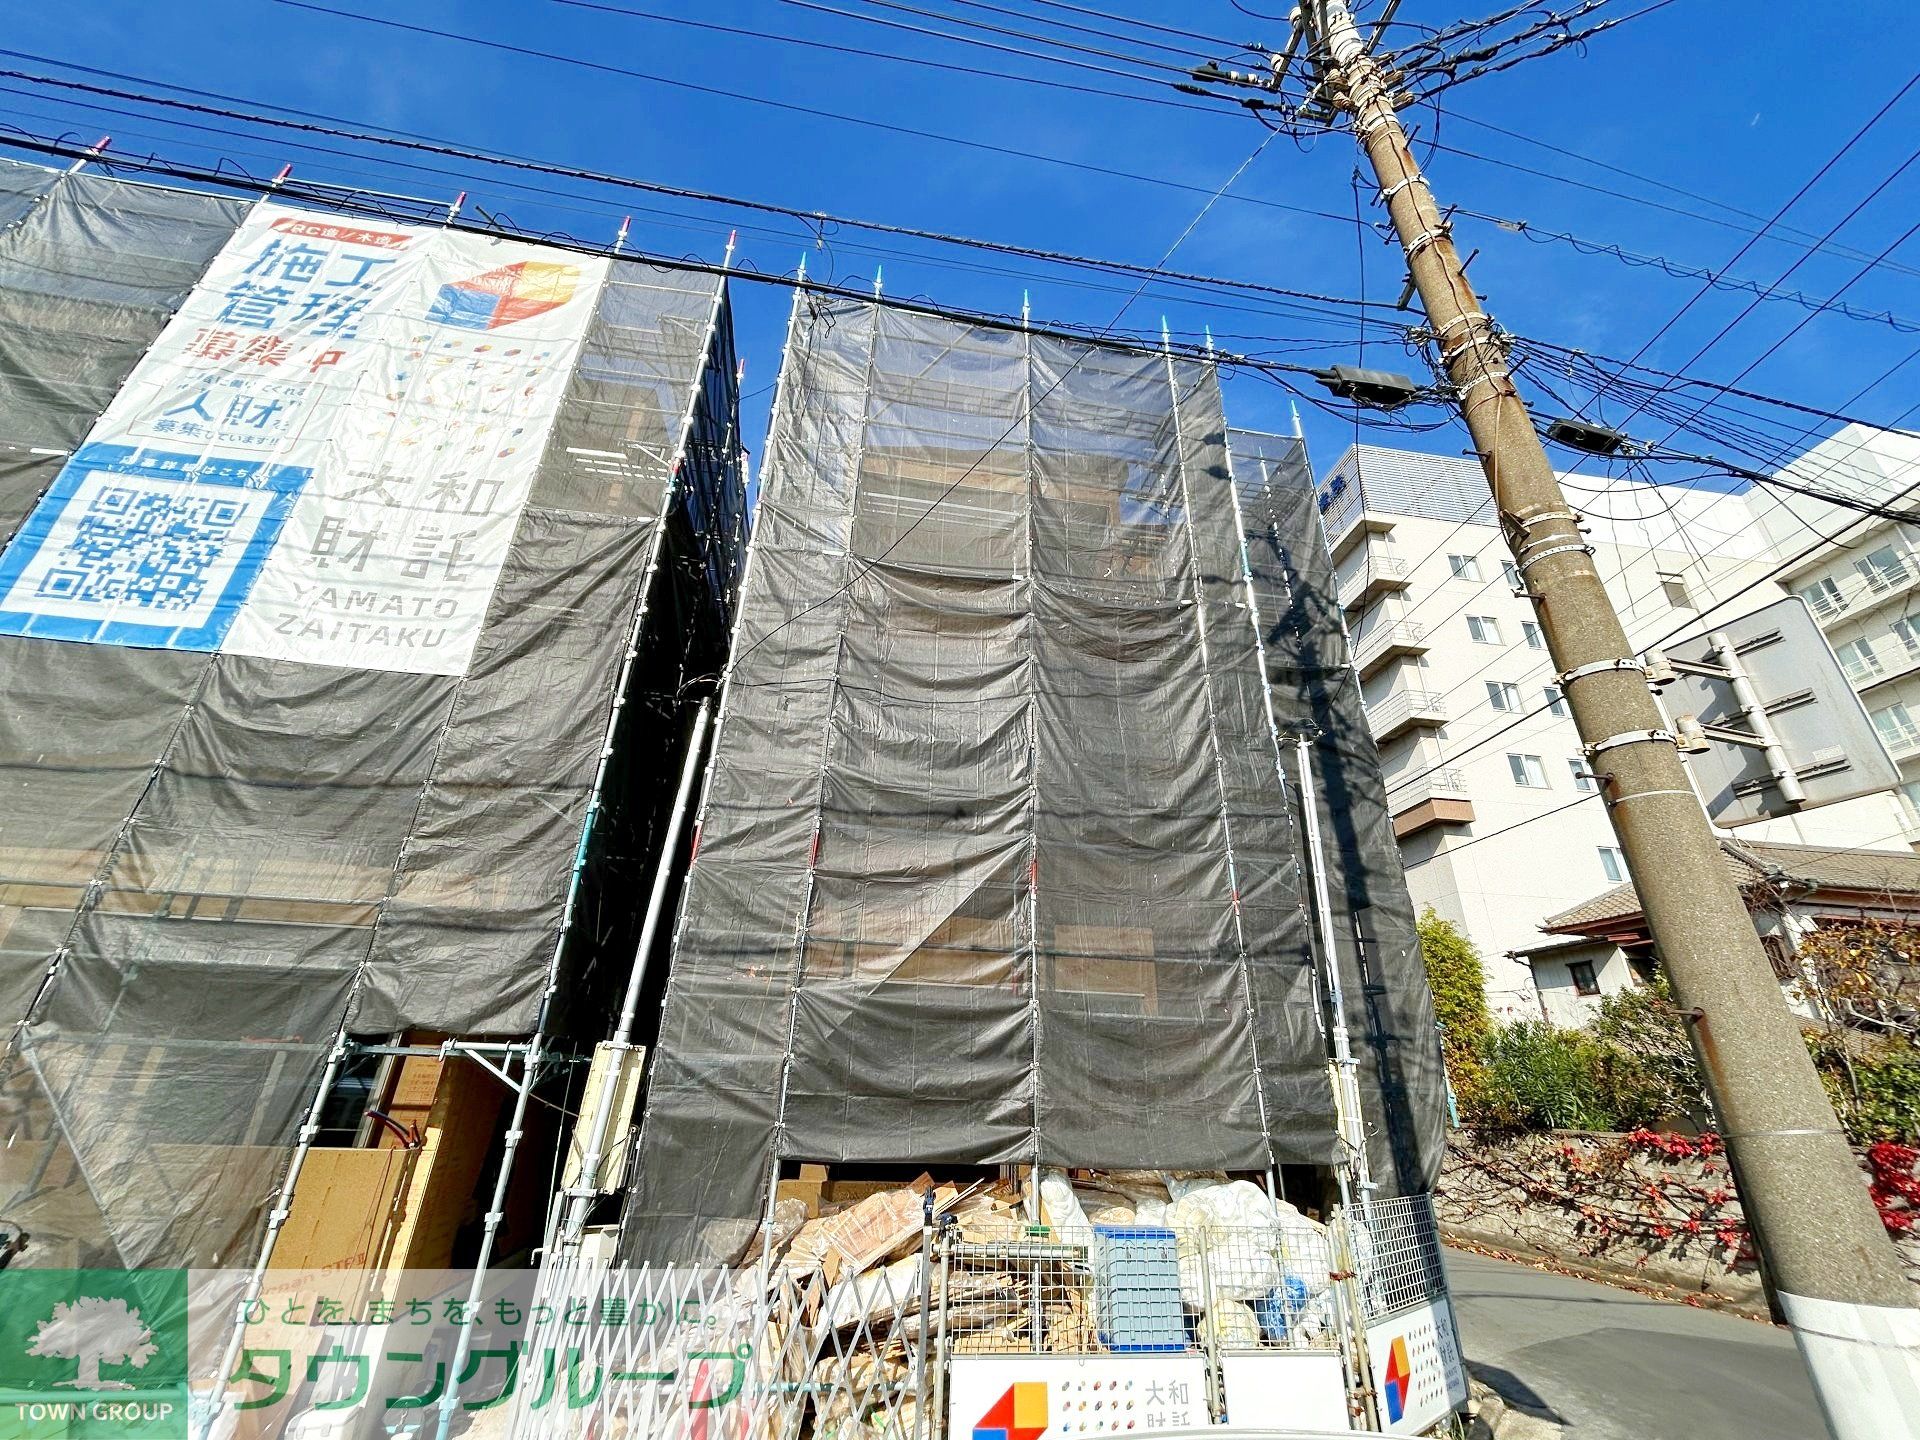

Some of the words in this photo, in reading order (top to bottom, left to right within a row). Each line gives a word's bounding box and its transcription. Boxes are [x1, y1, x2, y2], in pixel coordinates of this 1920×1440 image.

[242, 237, 397, 287] 施工
[215, 280, 374, 340] 管理
[337, 461, 505, 518] 大和
[302, 515, 477, 582] 財託
[293, 582, 459, 619] YAMATO
[274, 612, 446, 648] ZAITAKU
[1145, 1380, 1189, 1405] 大和
